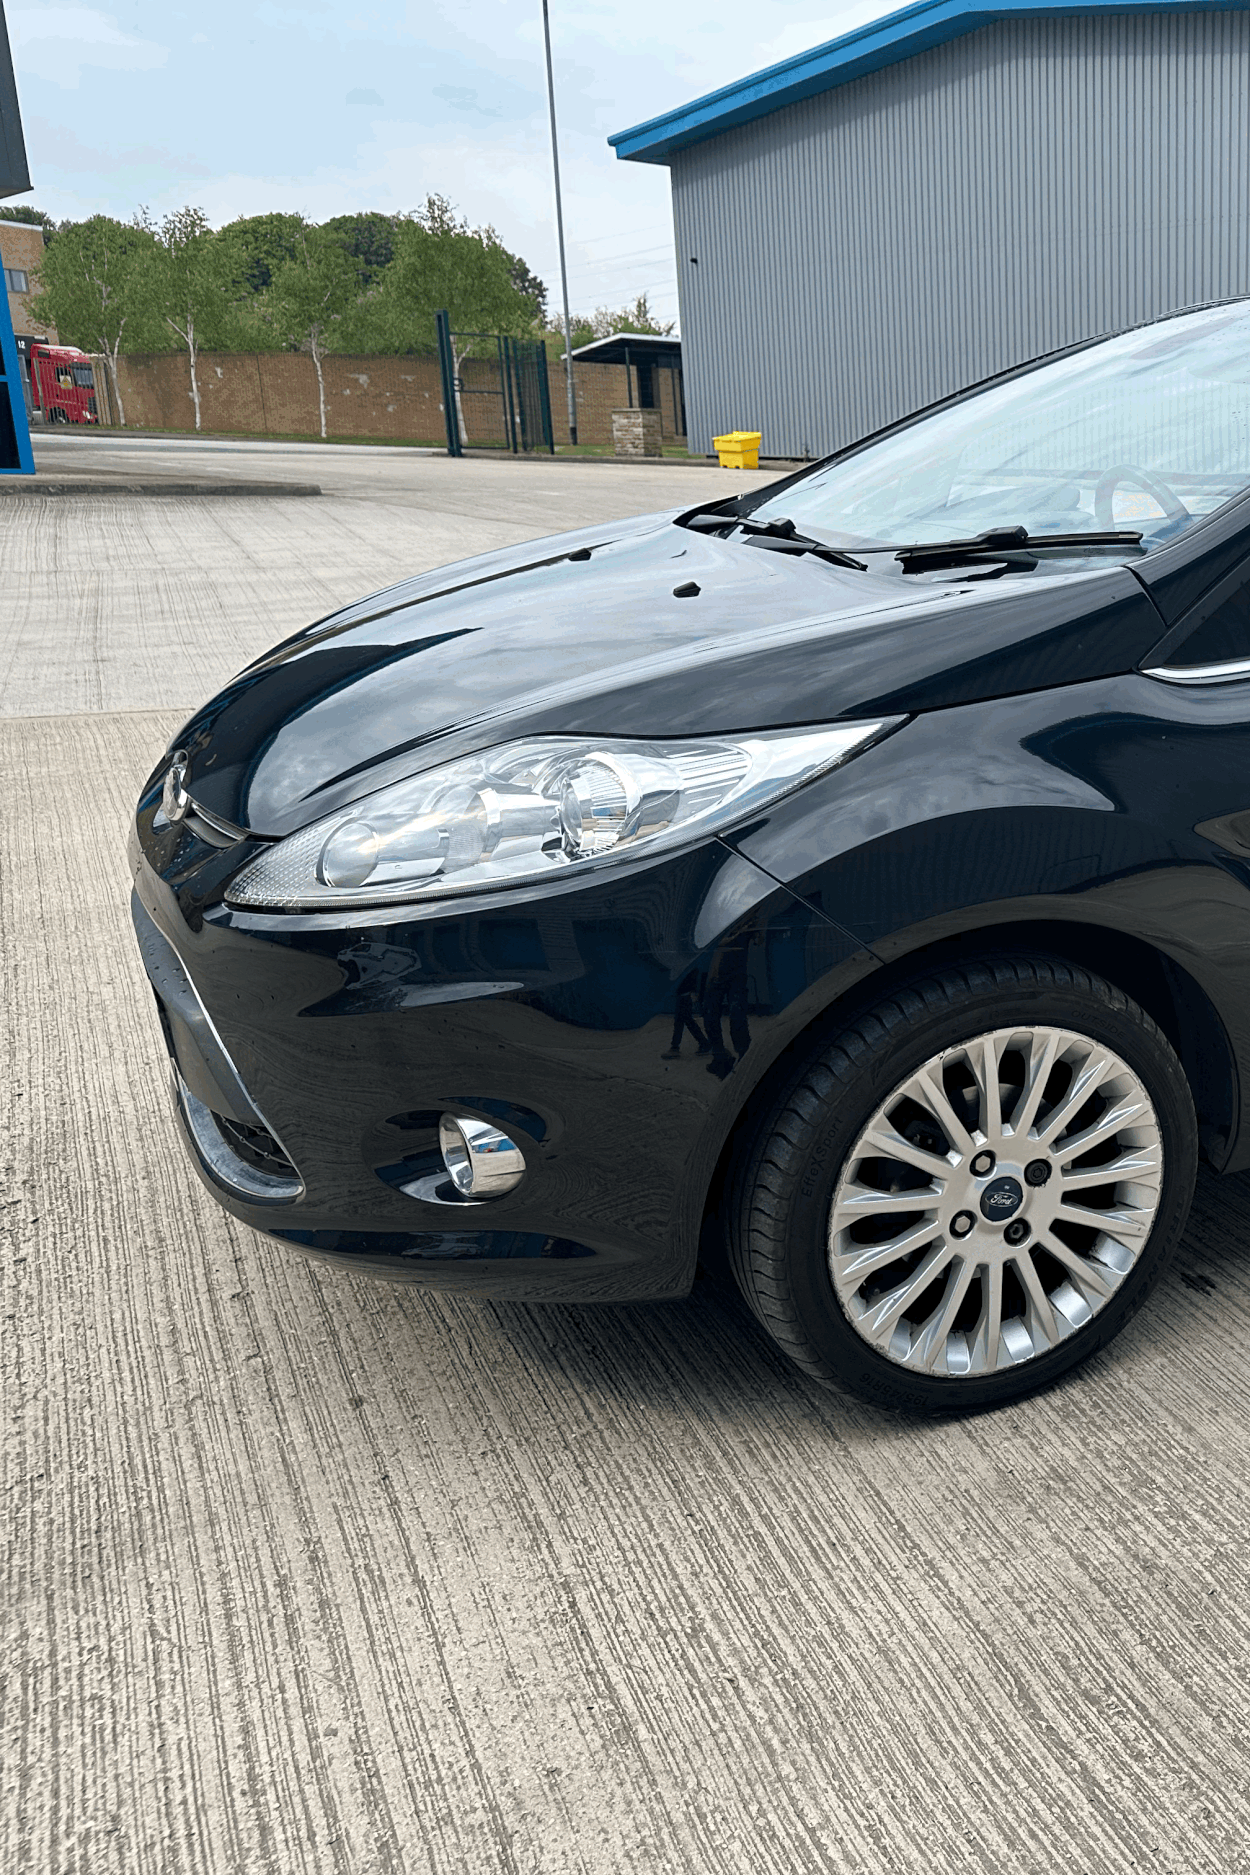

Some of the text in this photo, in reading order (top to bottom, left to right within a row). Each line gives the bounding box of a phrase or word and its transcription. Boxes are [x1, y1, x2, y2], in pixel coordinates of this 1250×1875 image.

[17, 341, 26, 349] 12
[1071, 1009, 1126, 1039] OUTSIDE
[990, 1193, 1013, 1205] Ford
[859, 1372, 930, 1407] 195/45R16
